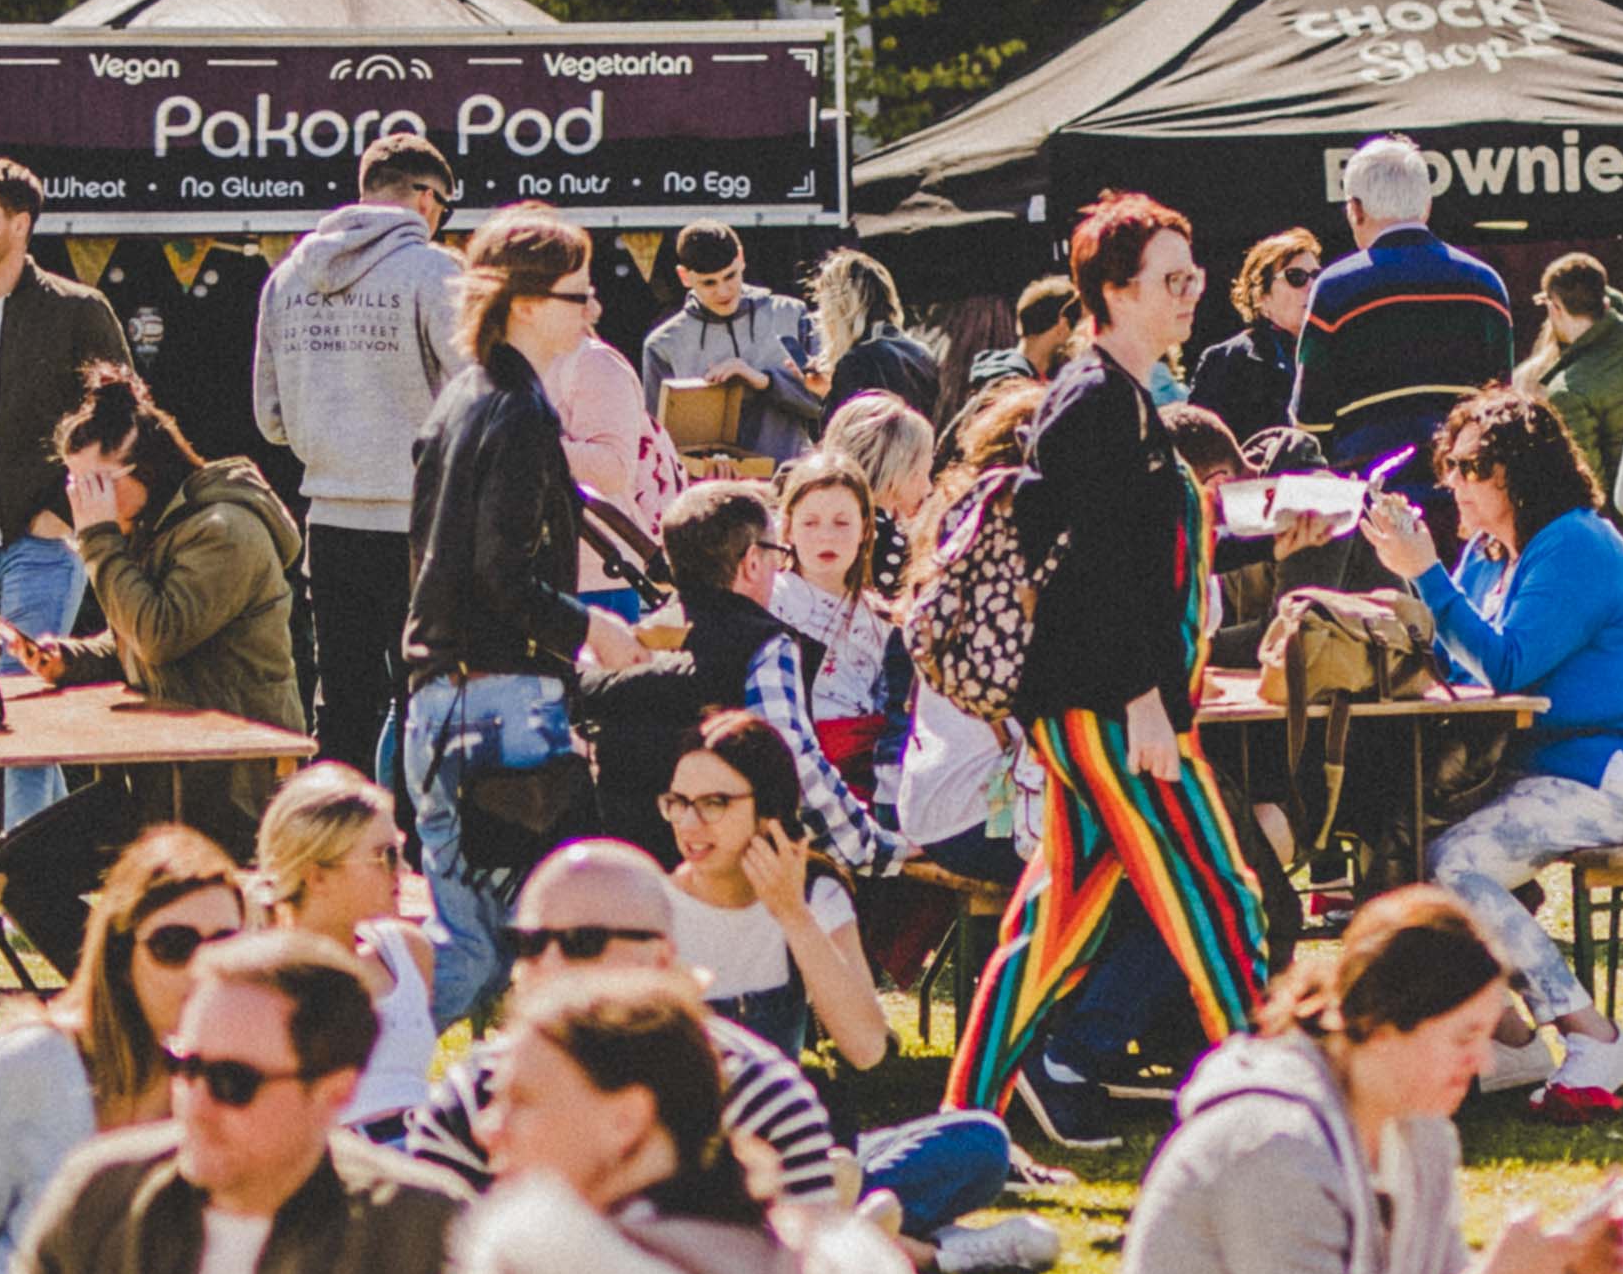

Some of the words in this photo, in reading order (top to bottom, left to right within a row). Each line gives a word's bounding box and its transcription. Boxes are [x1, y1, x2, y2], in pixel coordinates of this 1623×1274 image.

[88, 52, 180, 86] Vegan
[542, 50, 693, 84] Vegetarian
[1359, 37, 1527, 85] Shop
[457, 88, 604, 158] Pod
[42, 176, 127, 199] Wheat
[180, 176, 215, 199] No
[220, 176, 305, 199] Gluten
[517, 173, 553, 196] No
[559, 172, 612, 195] Nuts
[662, 170, 697, 193] No
[703, 171, 751, 199] Egg
[285, 292, 335, 310] JACK
[343, 292, 402, 309] WILLS
